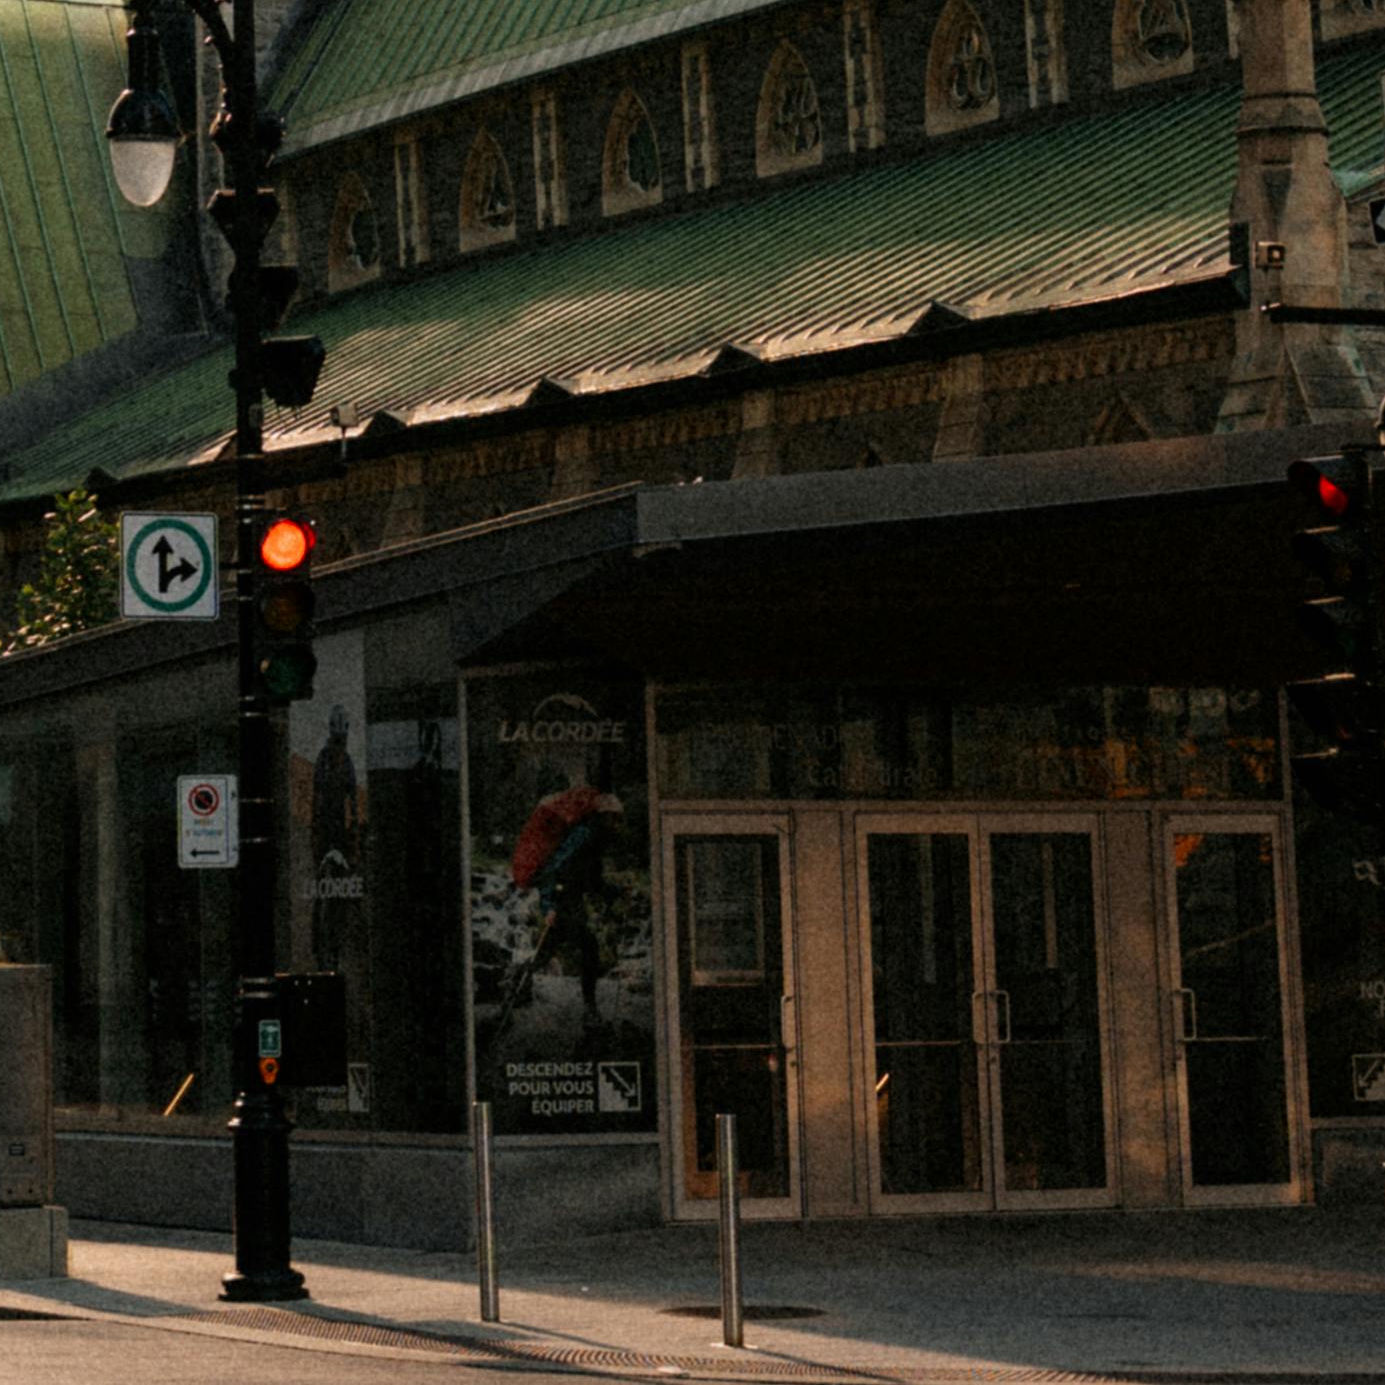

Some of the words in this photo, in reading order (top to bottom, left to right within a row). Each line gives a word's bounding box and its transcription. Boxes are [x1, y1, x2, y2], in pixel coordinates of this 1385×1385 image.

[498, 719, 530, 743] LA
[531, 717, 627, 743] CORDÉE
[505, 1061, 594, 1077] DESCENDEZ
[508, 1081, 551, 1096] POUR
[552, 1079, 595, 1095] VOUS
[531, 1097, 595, 1117] ÉQUIPER
